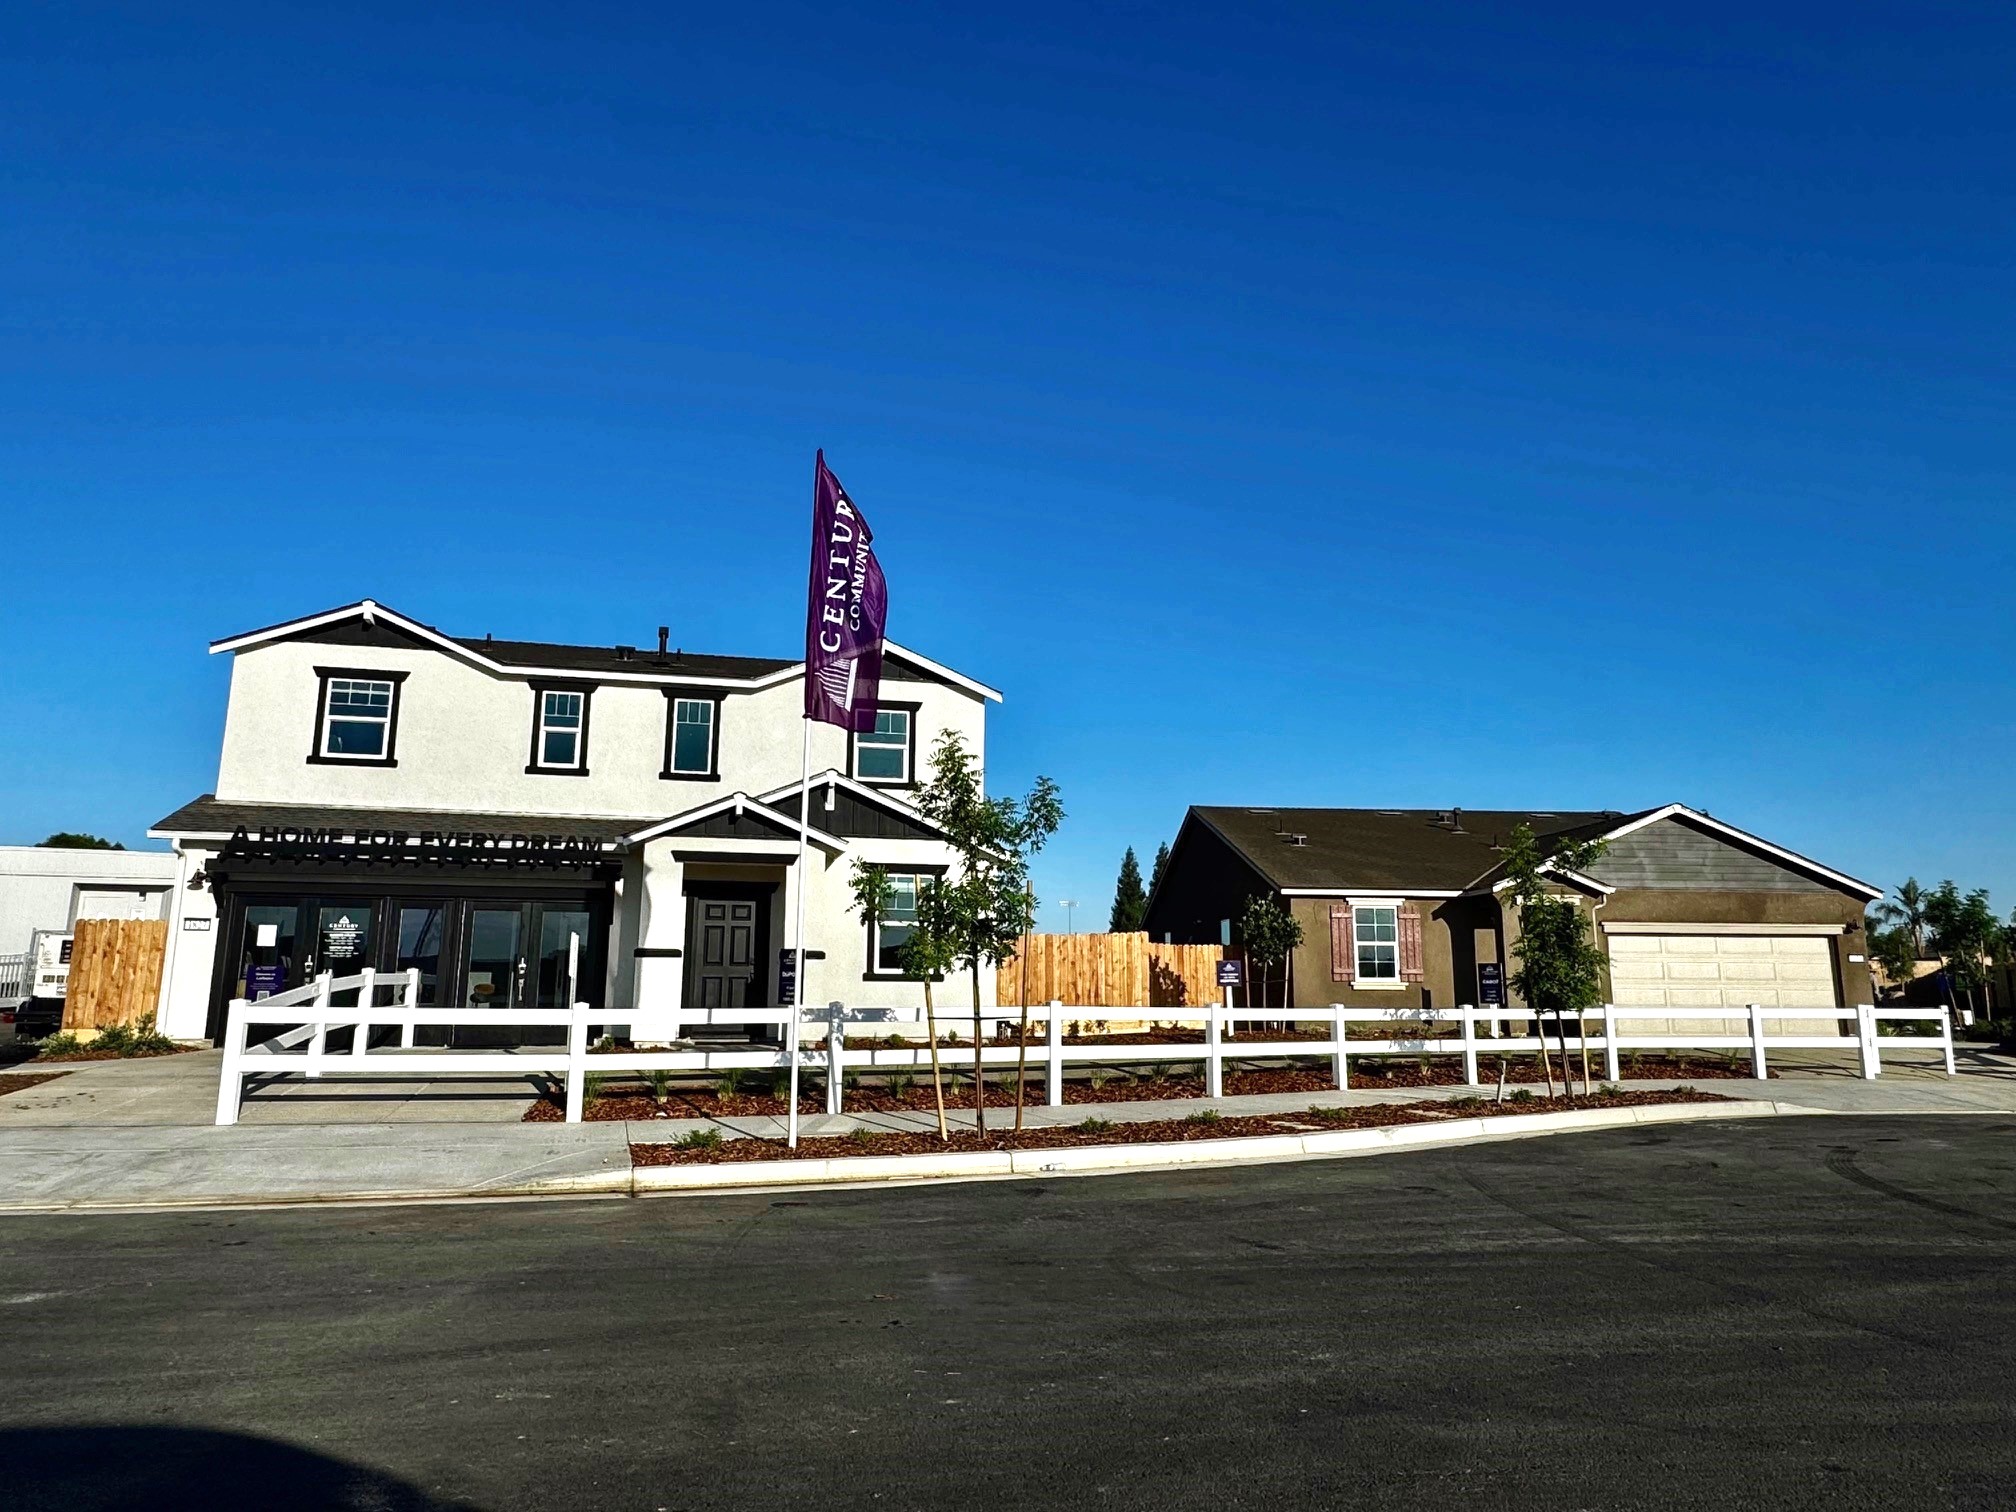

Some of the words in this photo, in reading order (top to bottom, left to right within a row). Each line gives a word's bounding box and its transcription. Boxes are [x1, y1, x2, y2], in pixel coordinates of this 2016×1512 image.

[820, 489, 855, 653] CENTUR
[230, 825, 250, 844] A
[260, 826, 344, 846] HOME
[355, 829, 409, 847] FOR
[420, 831, 505, 848] EVERY
[512, 834, 603, 851] DREAM
